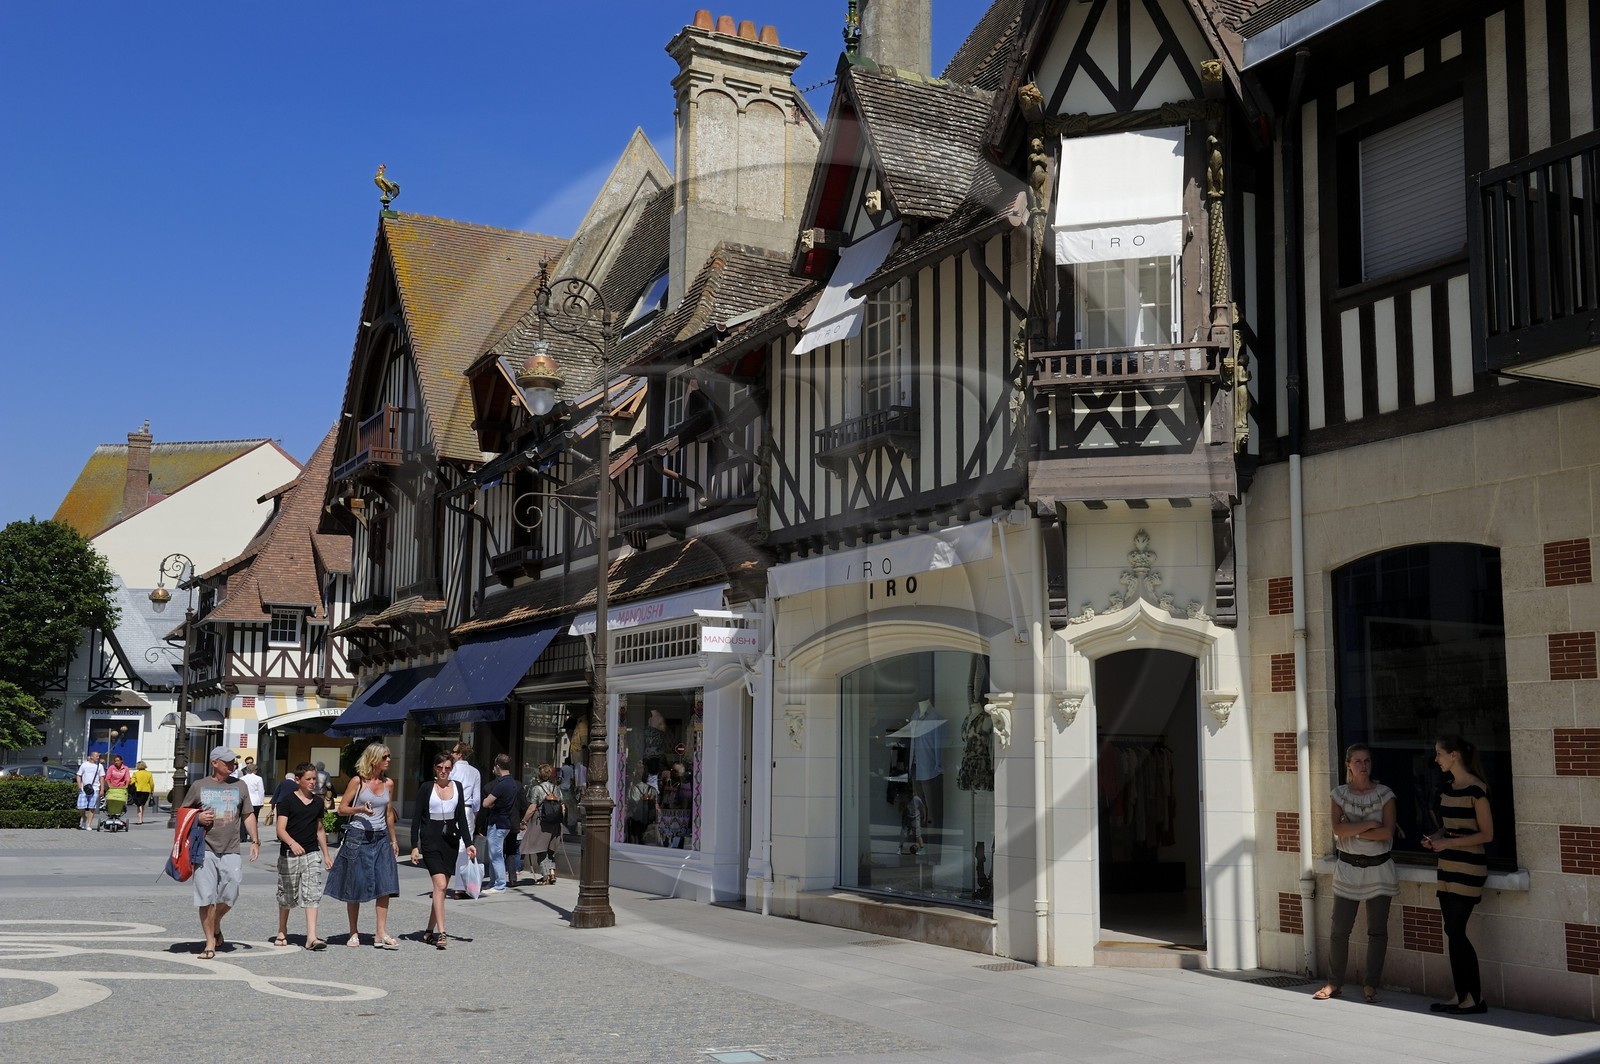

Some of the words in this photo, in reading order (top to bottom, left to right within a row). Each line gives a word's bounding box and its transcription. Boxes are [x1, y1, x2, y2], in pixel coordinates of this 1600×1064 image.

[1091, 235, 1145, 250] IRO
[816, 325, 841, 341] IRO
[846, 557, 892, 580] IRO
[869, 576, 918, 600] IRO
[618, 604, 659, 625] MANOUSH
[703, 635, 751, 646] MANOUSH
